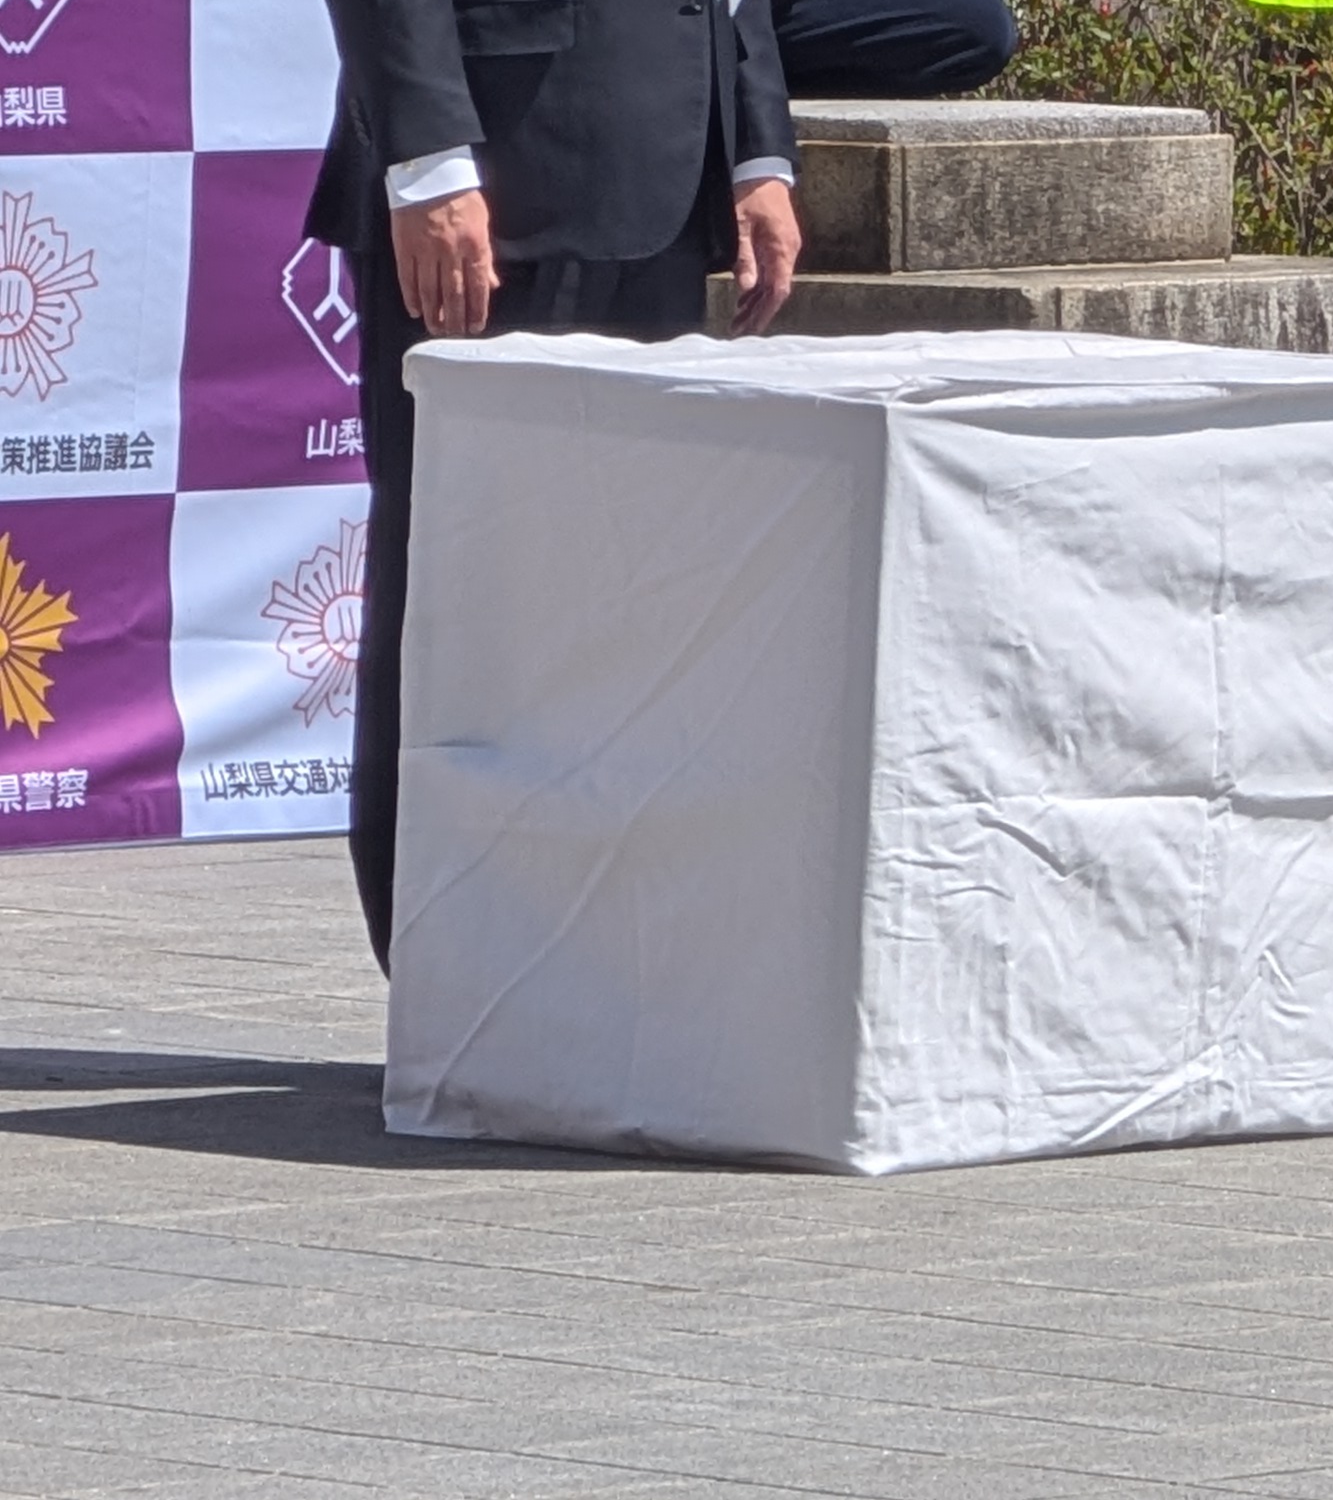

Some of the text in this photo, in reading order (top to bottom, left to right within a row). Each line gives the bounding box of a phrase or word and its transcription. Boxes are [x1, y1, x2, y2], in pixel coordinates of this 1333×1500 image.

[0, 86, 67, 127] 梨県
[1, 431, 155, 475] 策推進協議会
